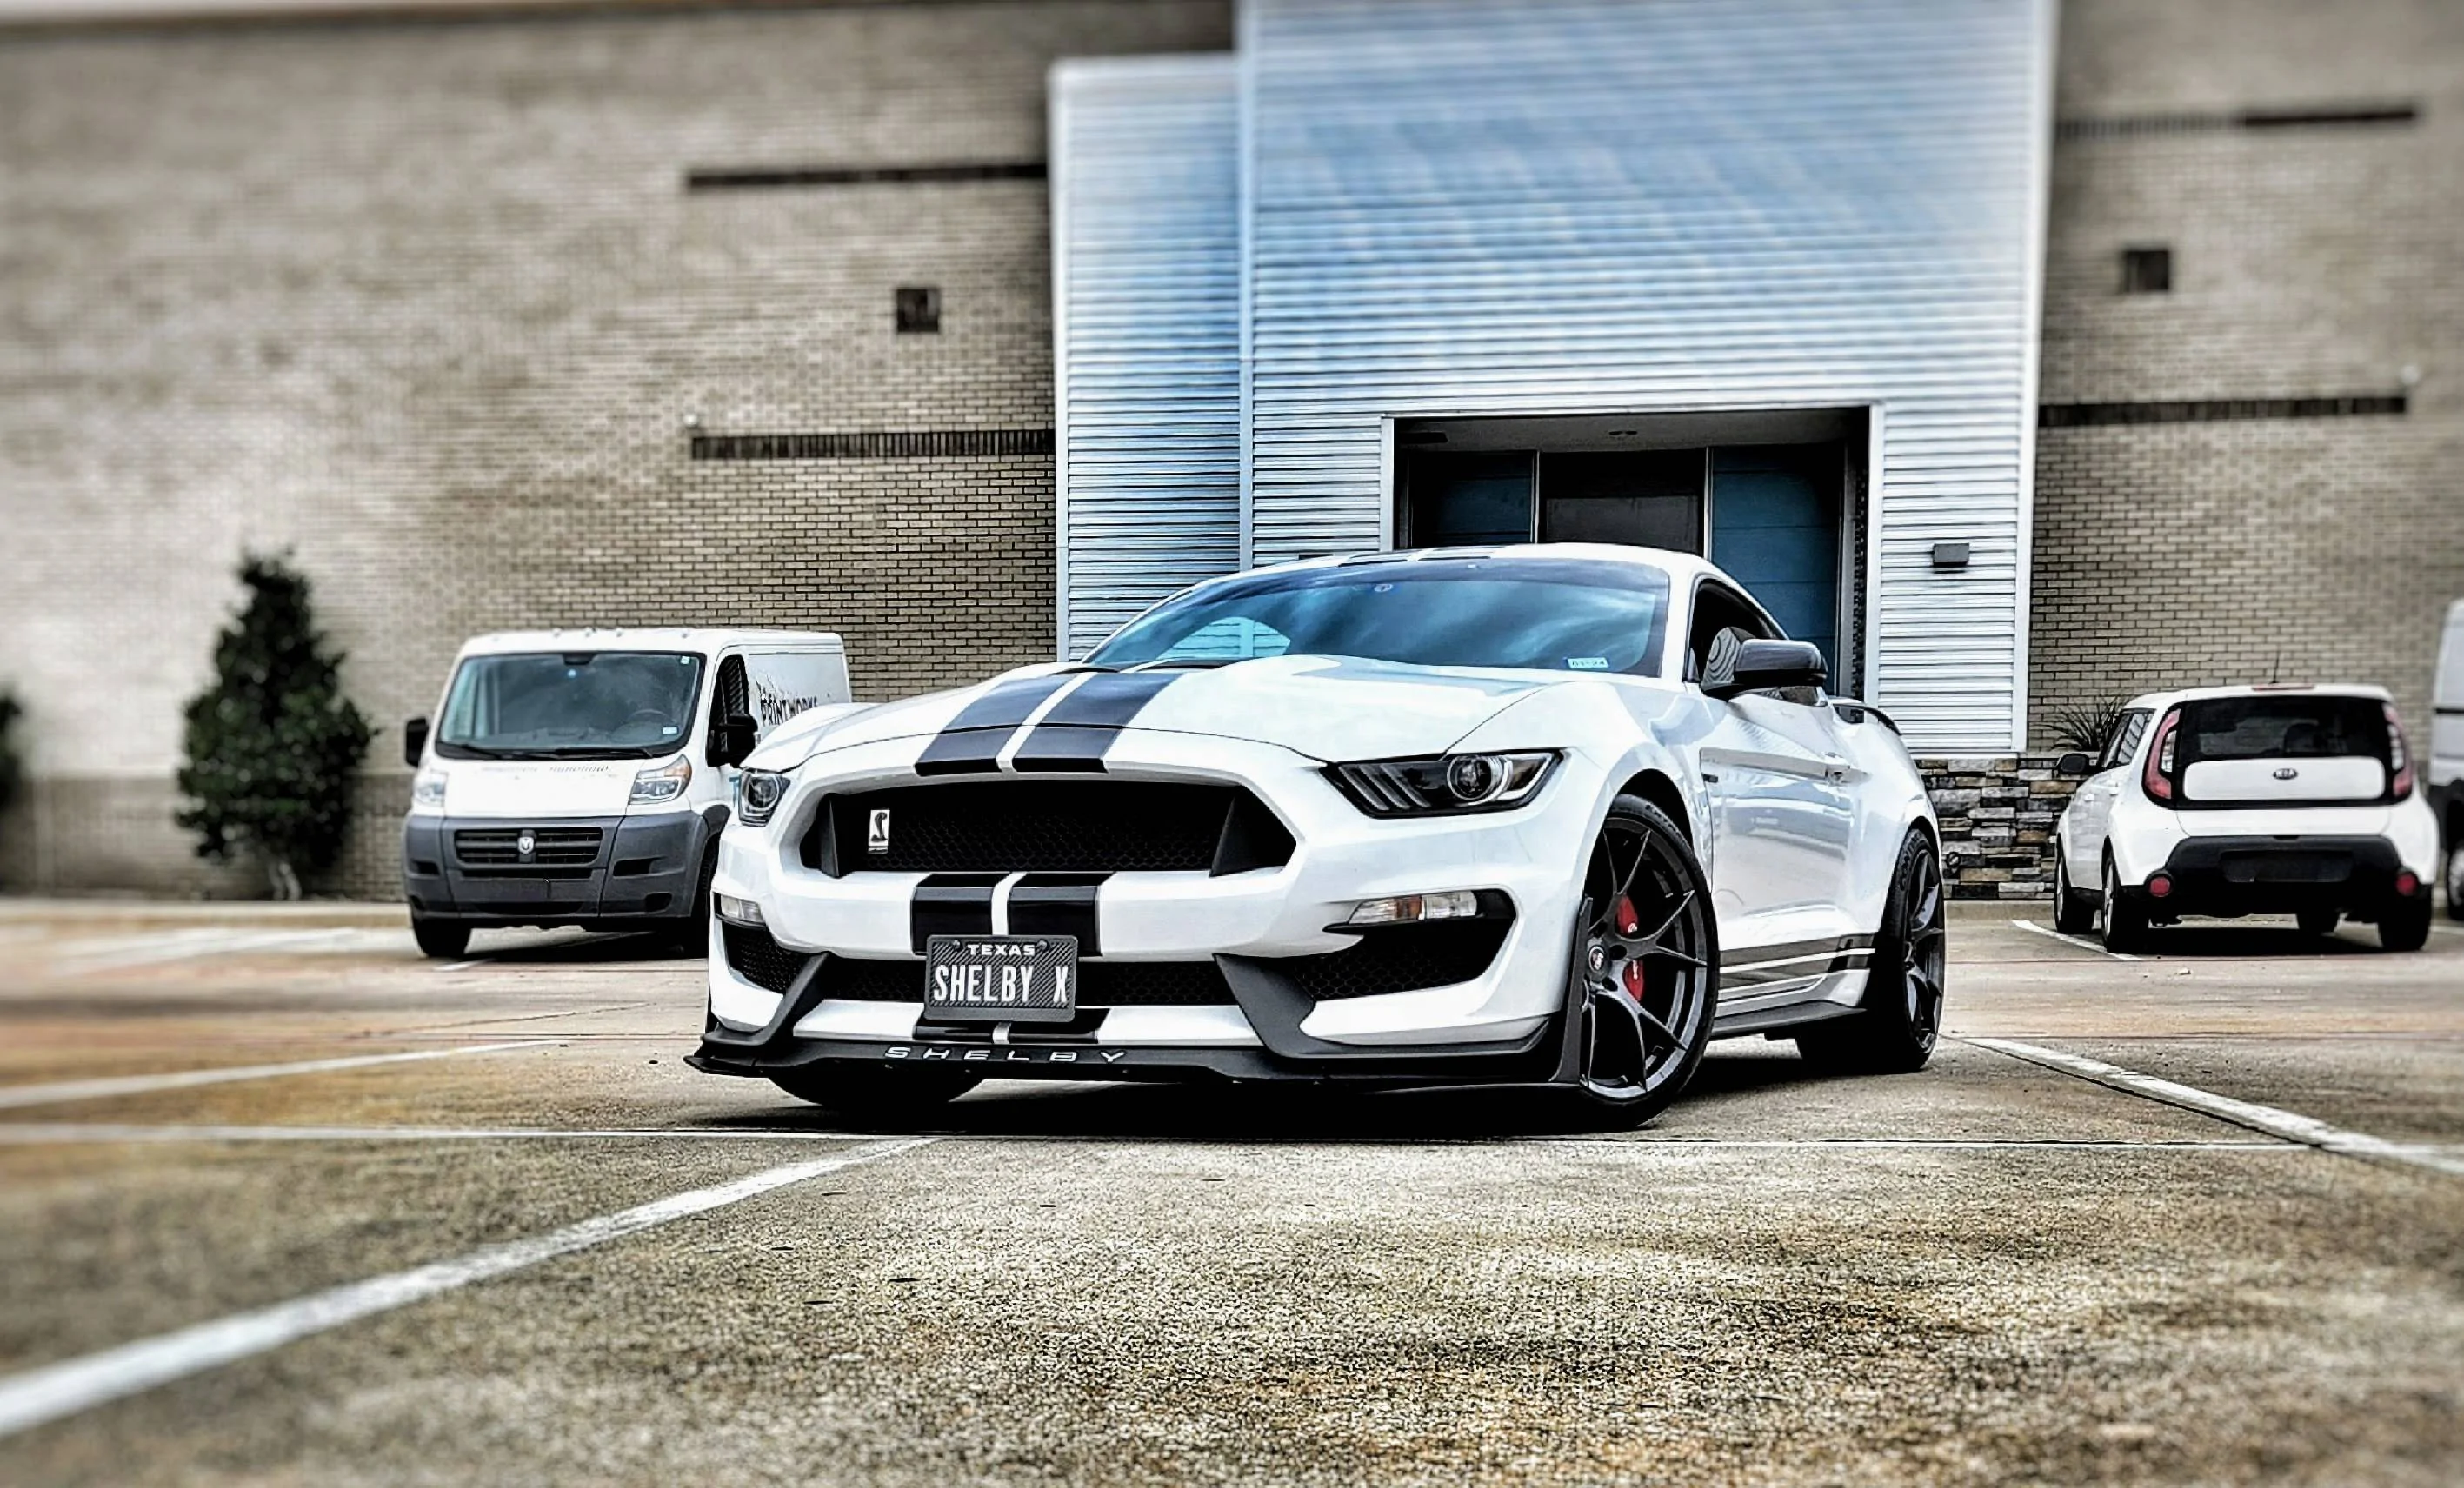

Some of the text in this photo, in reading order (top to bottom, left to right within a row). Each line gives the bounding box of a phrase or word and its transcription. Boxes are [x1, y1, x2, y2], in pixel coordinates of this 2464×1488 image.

[967, 944, 1036, 956] TEXAS
[933, 964, 1069, 1003] SHELBY X
[885, 1046, 1125, 1063] SHELBY
